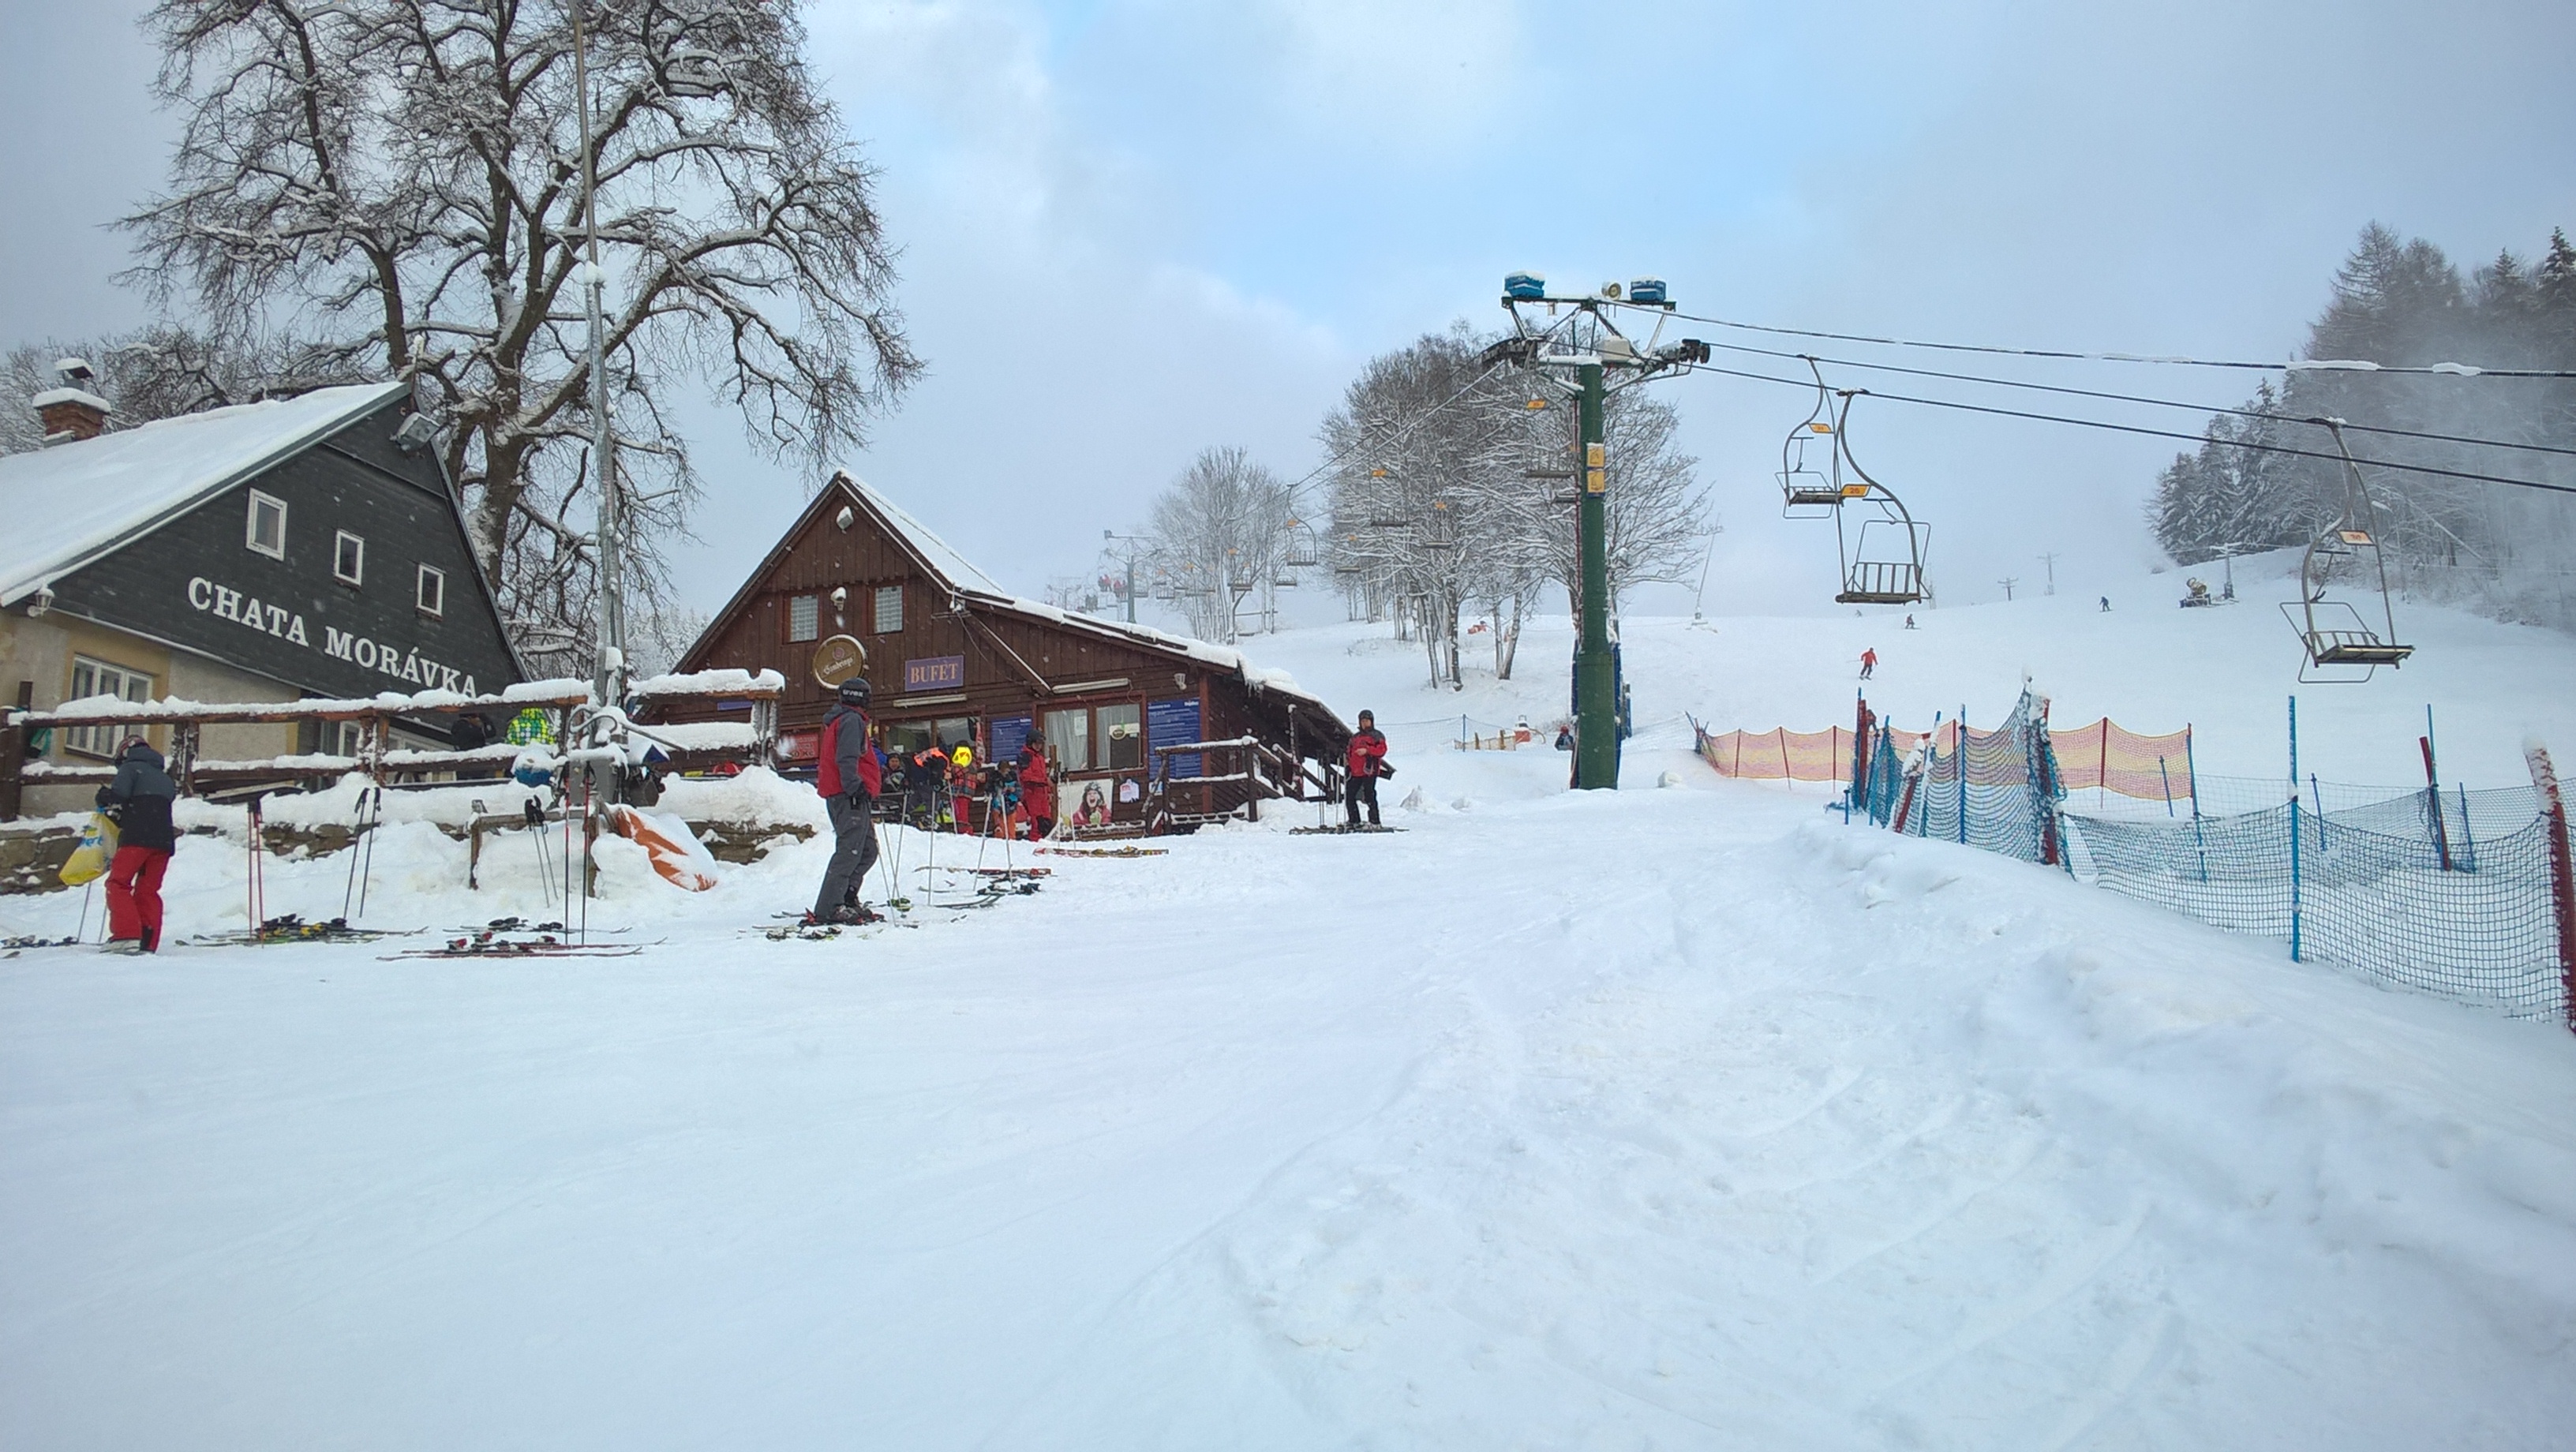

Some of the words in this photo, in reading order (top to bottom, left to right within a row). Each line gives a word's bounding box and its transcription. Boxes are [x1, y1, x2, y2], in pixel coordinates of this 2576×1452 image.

[188, 576, 309, 648] CHATA
[324, 626, 477, 699] MORÁVKA
[910, 663, 958, 684] BUFET
[842, 689, 864, 698] uvex
